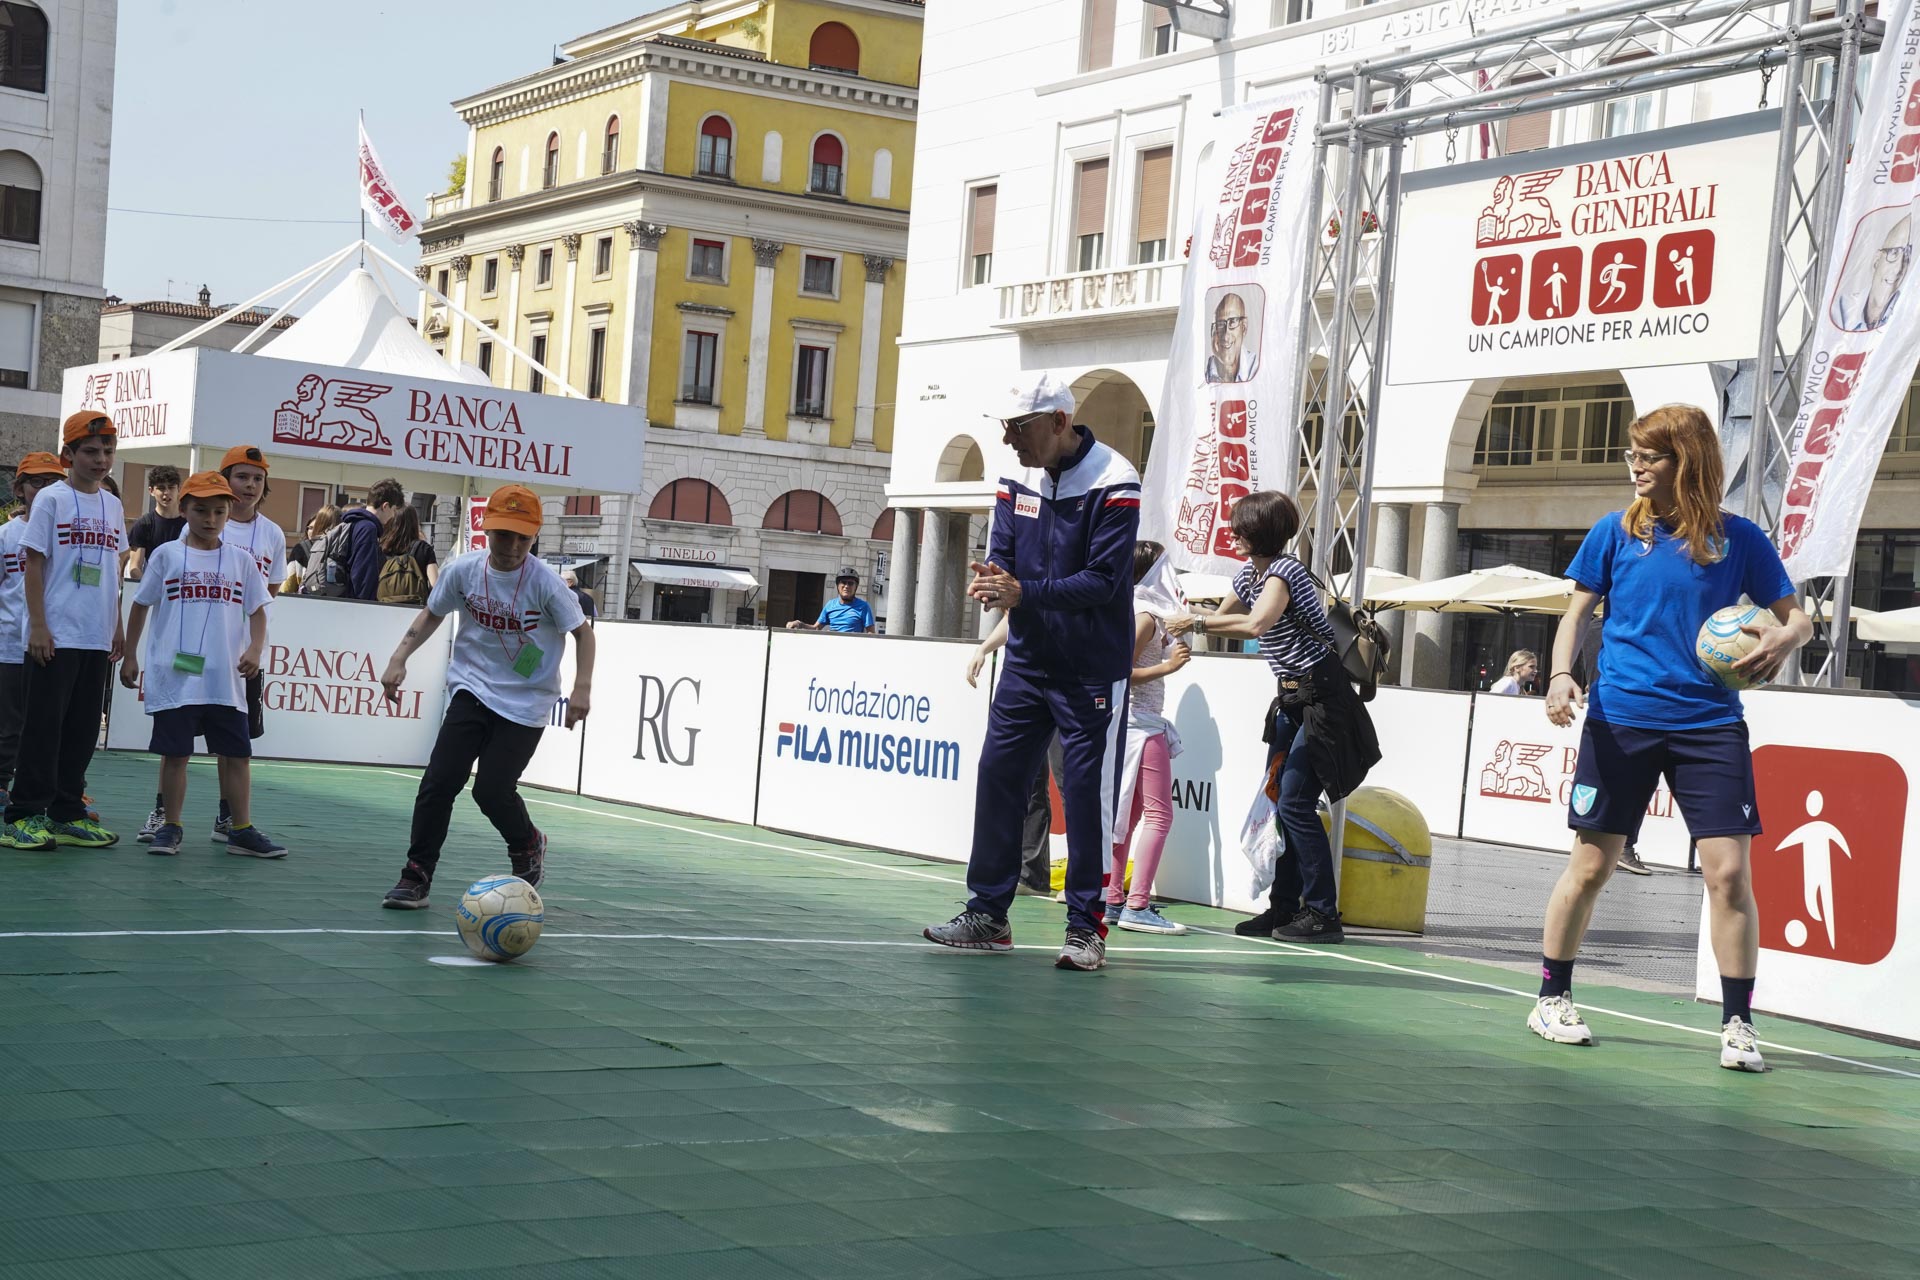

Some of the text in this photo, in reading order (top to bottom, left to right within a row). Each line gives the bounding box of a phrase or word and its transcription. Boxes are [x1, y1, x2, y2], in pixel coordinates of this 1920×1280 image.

[1220, 141, 1248, 204] BANCA
[1231, 115, 1268, 202] GENERALI
[1573, 151, 1674, 198] BANCA
[1261, 106, 1304, 265] UN CAMPIONE PER AMICO
[1571, 184, 1719, 237] GENERALI
[1468, 312, 1710, 353] UN CAMPIONE PER AMICO
[114, 368, 152, 403] BANCA
[113, 403, 168, 439] GENERALI
[407, 388, 526, 435] BANCA
[1248, 400, 1258, 444] AMICO
[404, 427, 573, 477] GENERALI
[1186, 432, 1212, 490] BANCA
[1249, 449, 1258, 471] PER
[660, 546, 716, 562] TINELLO
[681, 577, 720, 588] TINELLO
[265, 645, 380, 683] BANCA
[263, 680, 424, 720] GENERALI
[632, 674, 702, 767] RG
[808, 677, 930, 723] fondazione
[776, 722, 961, 781] FILA museum
[1171, 778, 1212, 812] ANI
